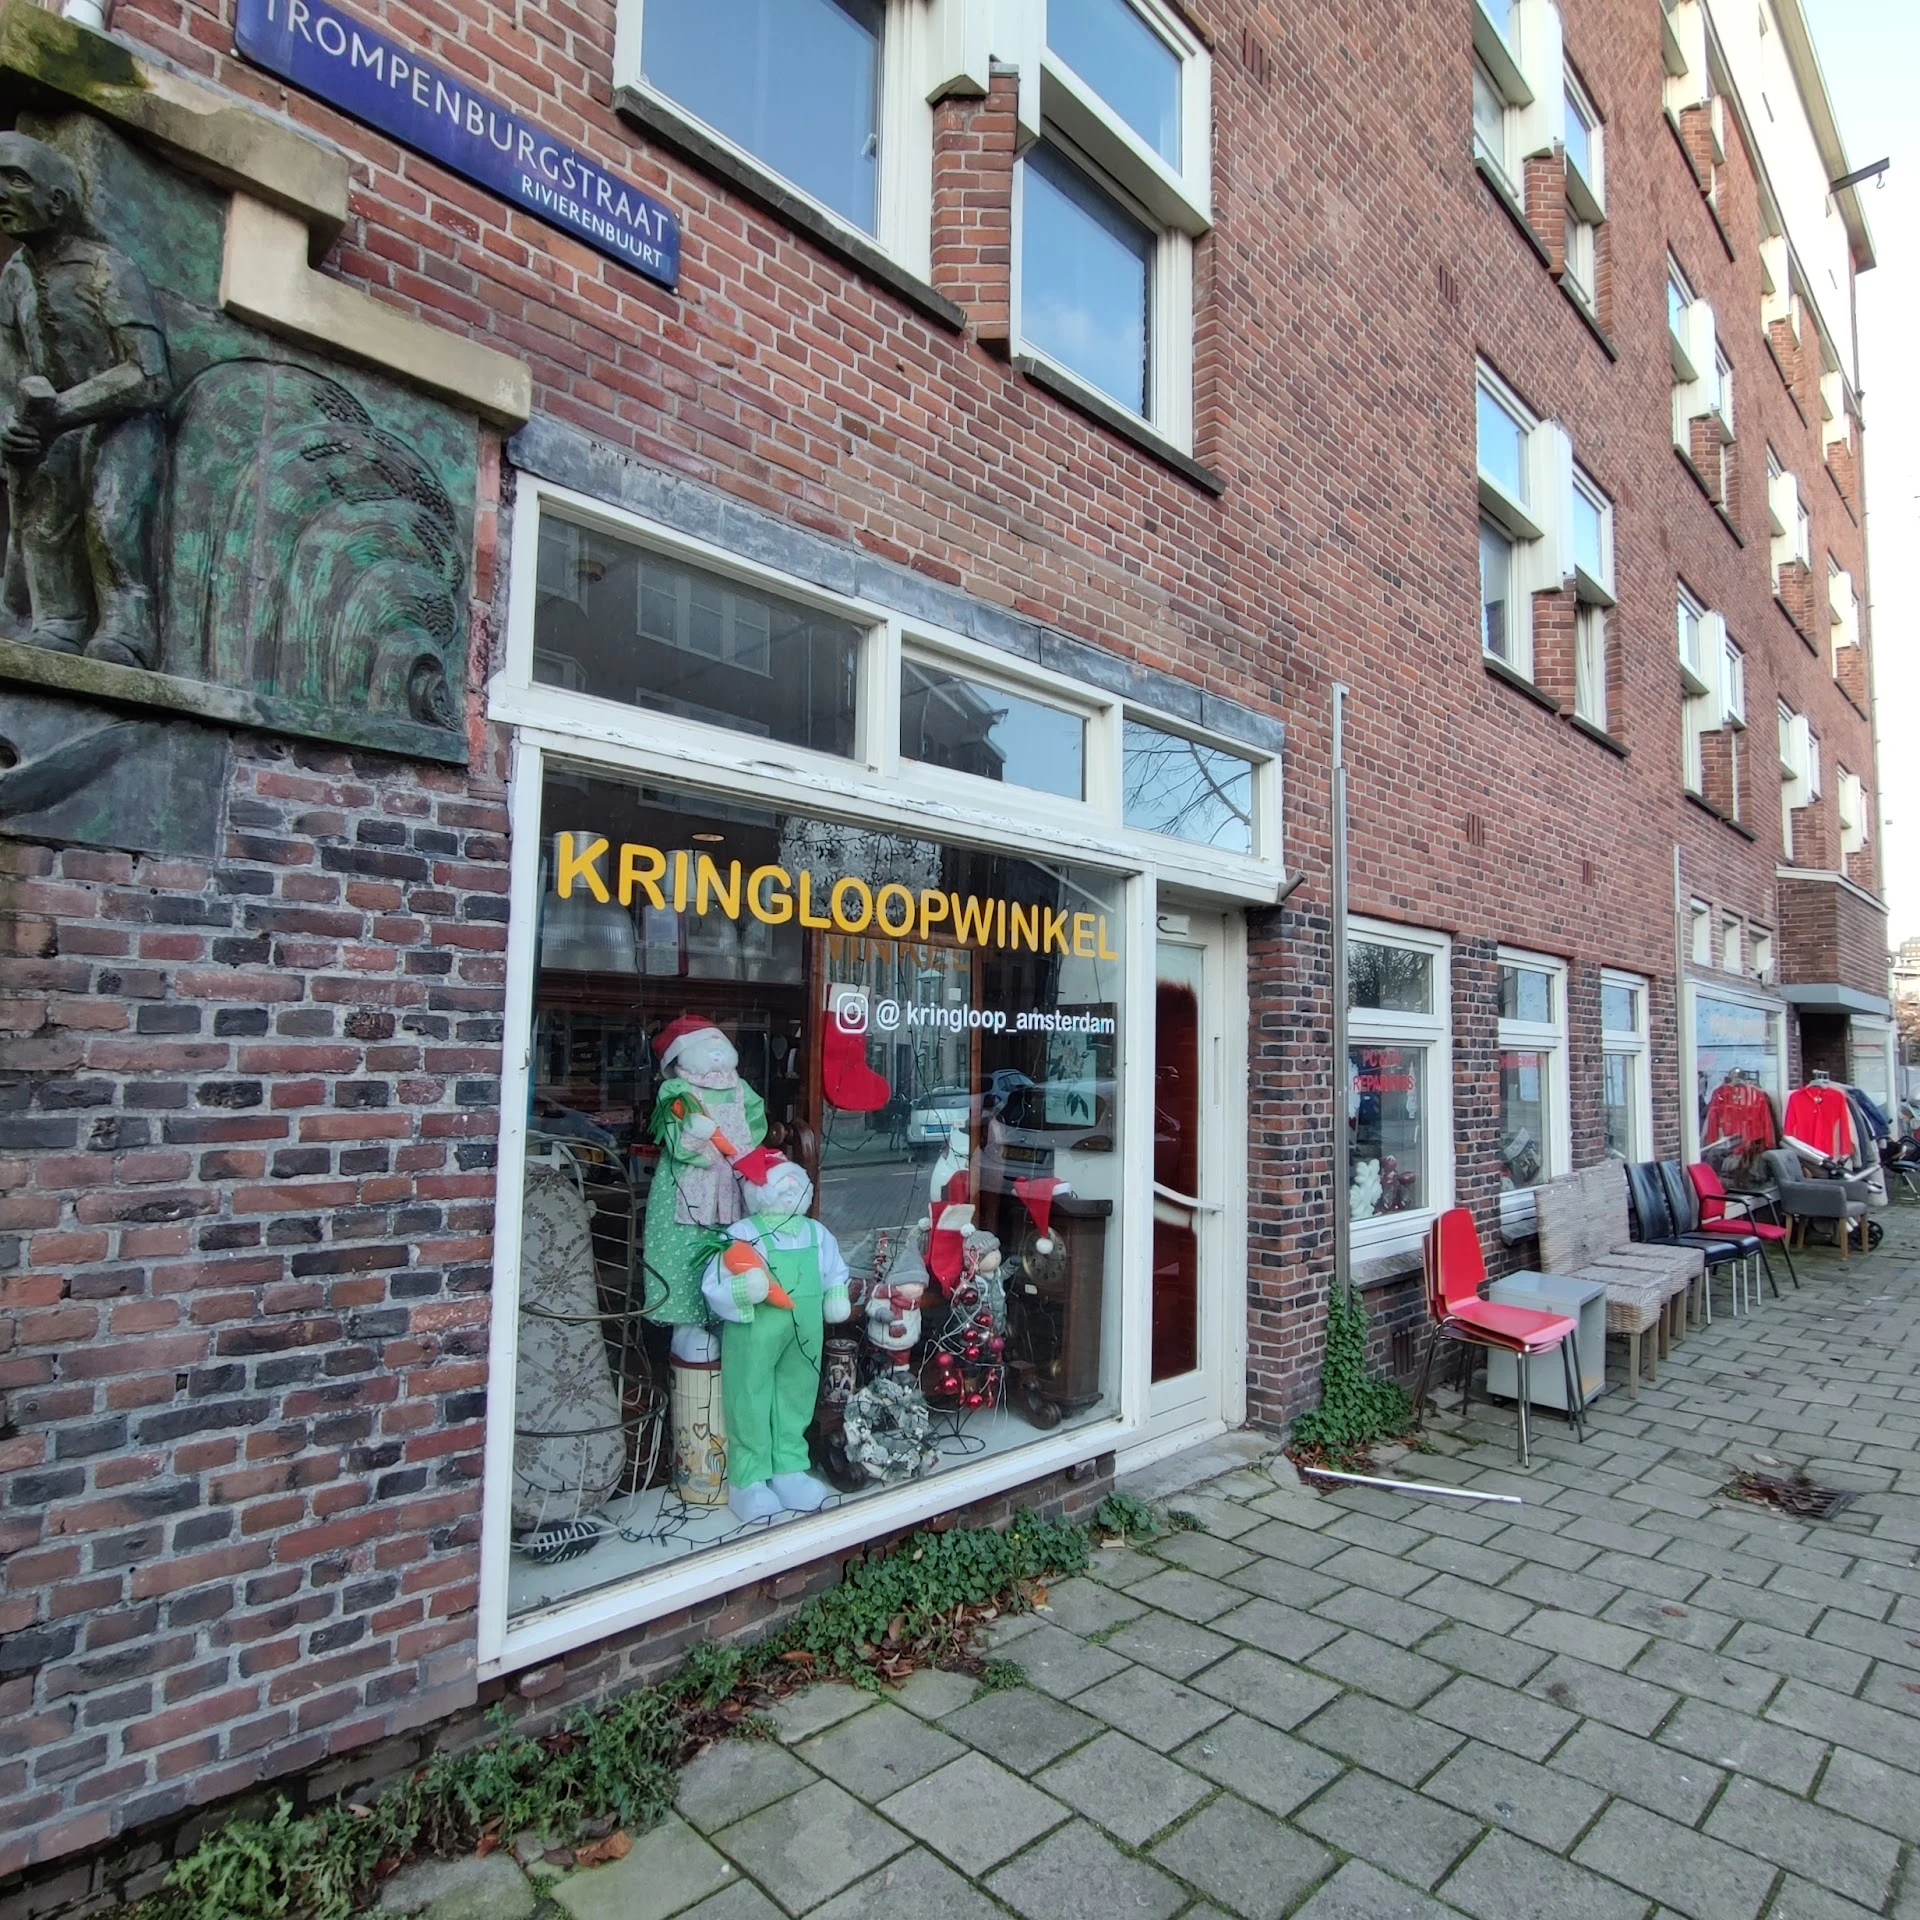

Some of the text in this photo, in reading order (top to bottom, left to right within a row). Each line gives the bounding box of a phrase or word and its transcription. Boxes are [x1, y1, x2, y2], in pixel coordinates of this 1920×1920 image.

[522, 174, 662, 267] RIVIERENBUURT
[557, 832, 1118, 960] KRINGLOOPWINKEL
[907, 1000, 1115, 1034] kringloop_amsterdam
